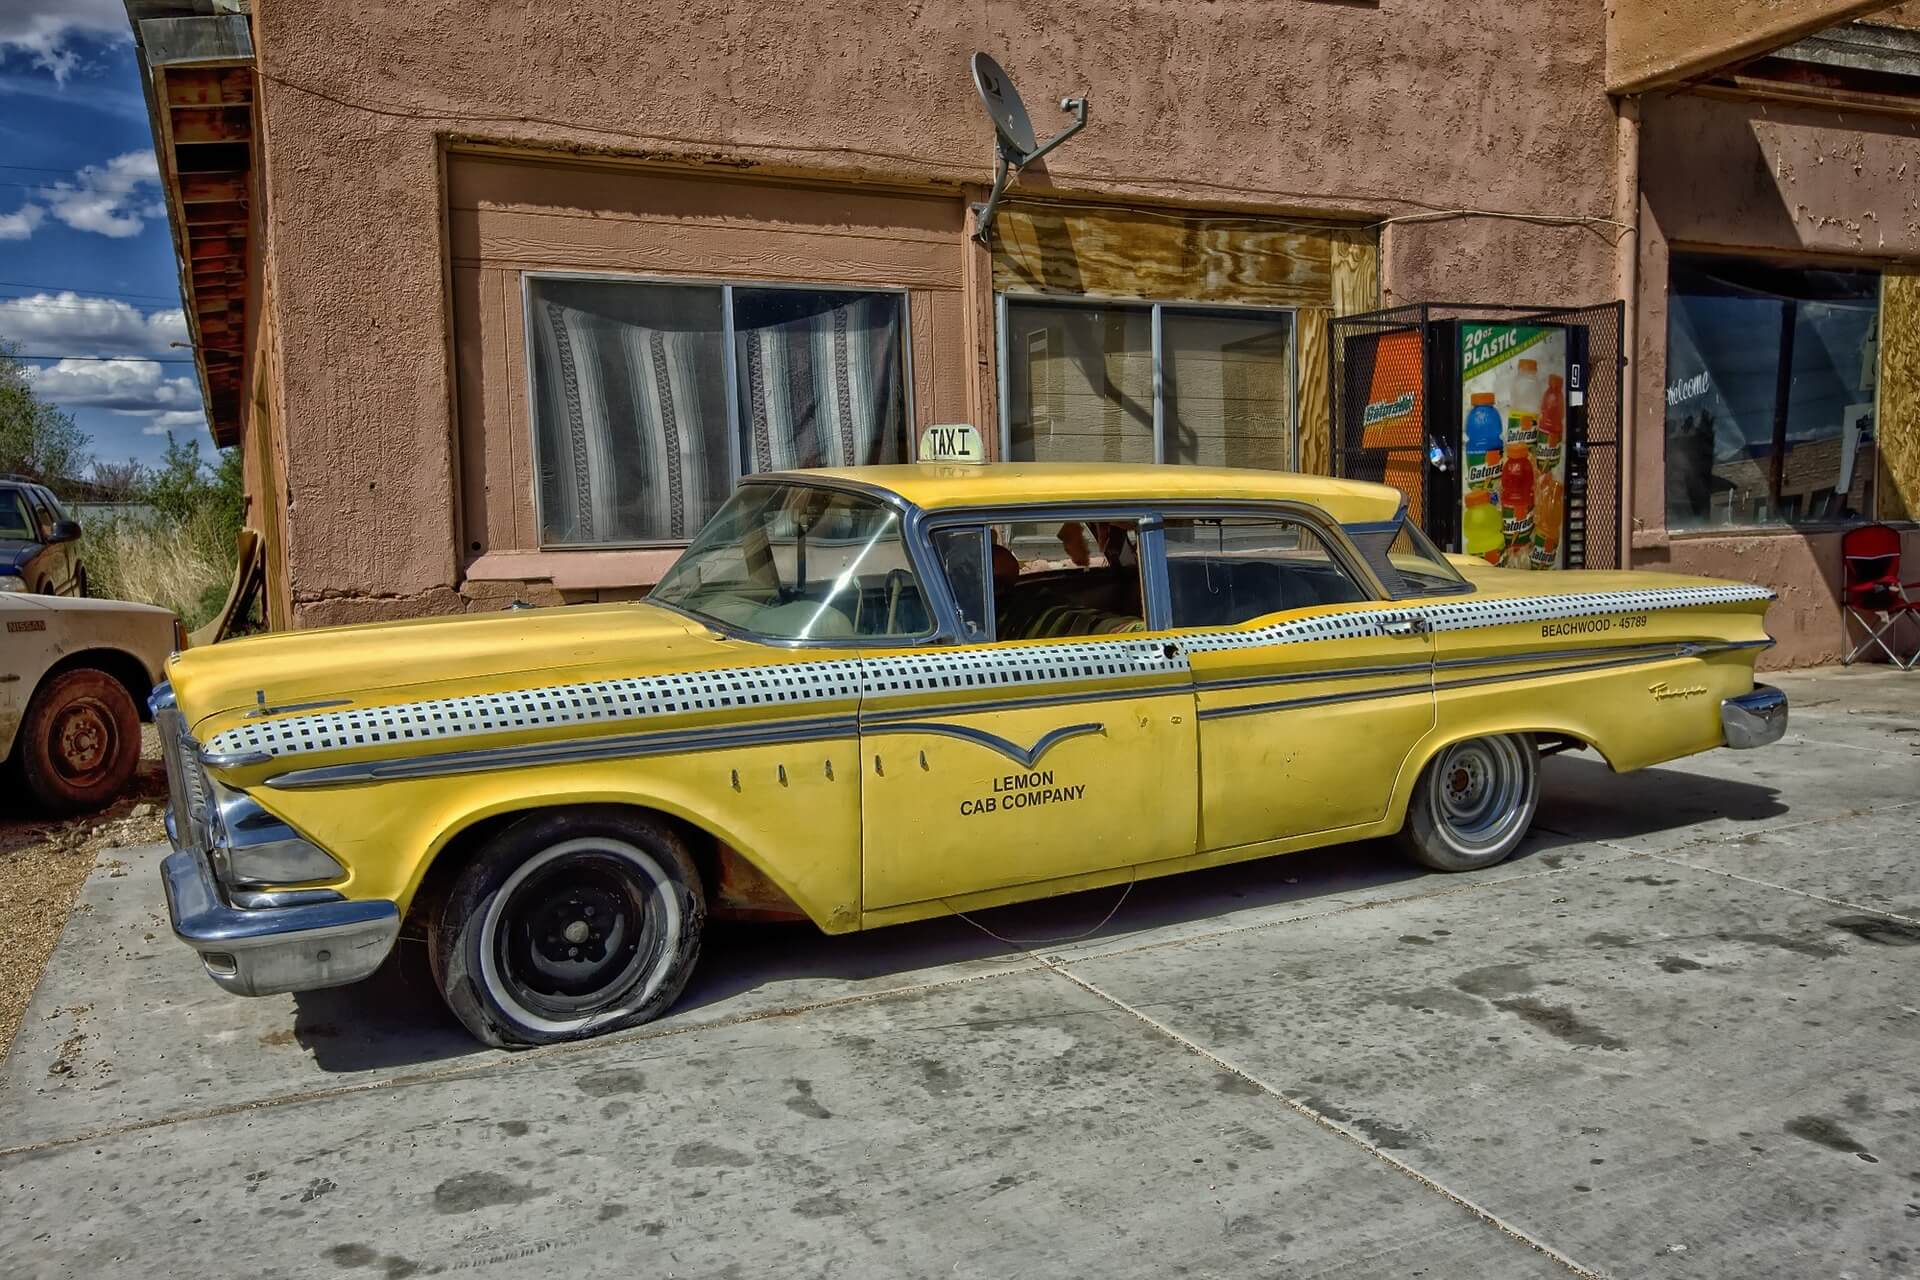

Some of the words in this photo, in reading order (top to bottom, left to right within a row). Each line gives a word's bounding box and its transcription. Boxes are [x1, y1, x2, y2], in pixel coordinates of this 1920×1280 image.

[1464, 328, 1518, 369] PLASTIC
[930, 428, 970, 456] TAXI
[1542, 619, 1611, 638] BEACHWOOD
[1619, 615, 1647, 630] 45789
[993, 770, 1054, 793] LEMON
[960, 797, 997, 816] CAB
[1002, 784, 1086, 810] COMPANY
